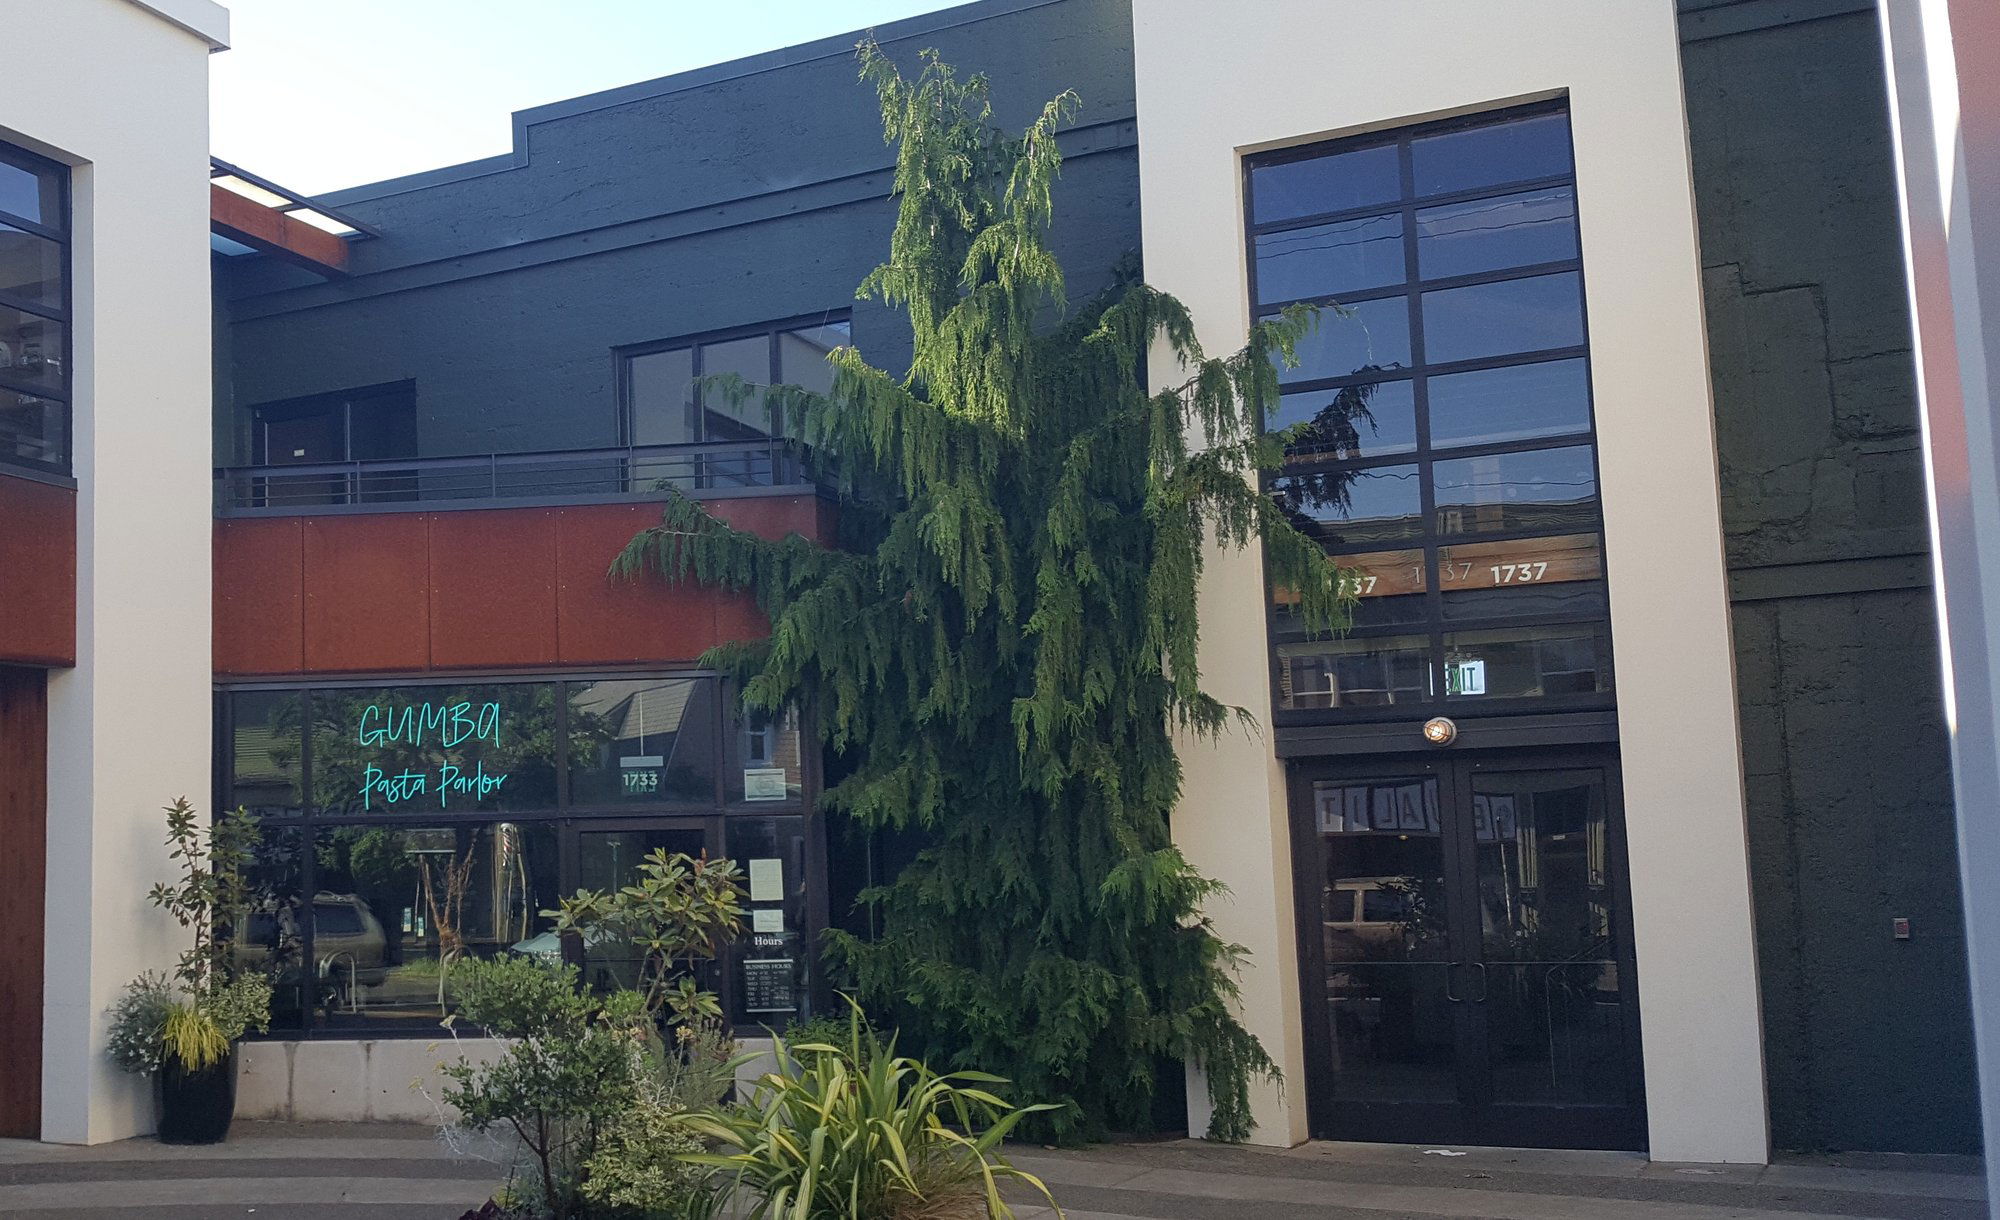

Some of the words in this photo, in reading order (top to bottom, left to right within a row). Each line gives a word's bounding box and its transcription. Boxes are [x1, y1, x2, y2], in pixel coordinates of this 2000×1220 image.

[1490, 562, 1548, 584] 1737
[358, 762, 427, 810] Pasta
[435, 760, 508, 808] Parlor
[622, 773, 658, 786] 1733
[754, 936, 783, 946] Hours
